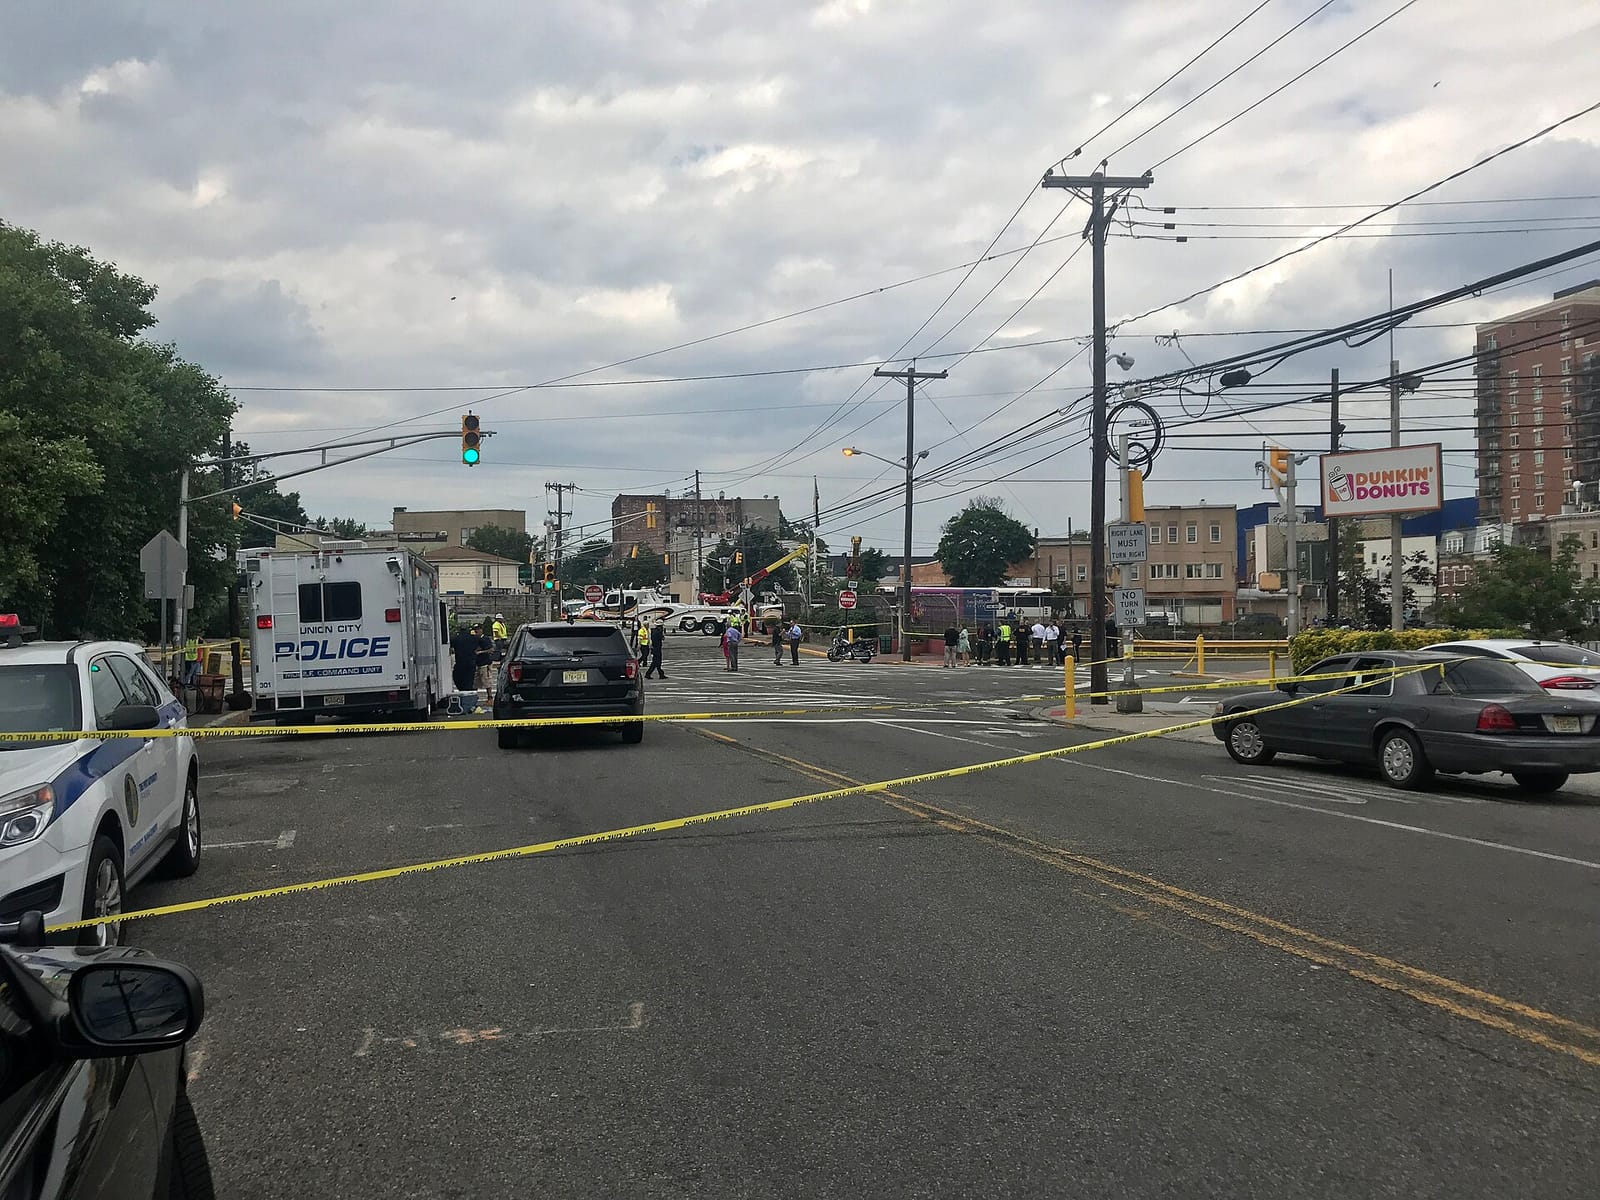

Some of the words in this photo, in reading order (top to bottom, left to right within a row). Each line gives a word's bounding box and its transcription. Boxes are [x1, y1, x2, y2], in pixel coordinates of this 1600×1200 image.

[1355, 467, 1433, 486] DUNKIN'
[1356, 482, 1430, 500] DONUTS
[1117, 539, 1138, 547] MUST
[1128, 550, 1145, 558] RIGHT
[1122, 591, 1136, 600] NO
[300, 625, 333, 635] UNION
[337, 624, 362, 633] CITY
[272, 636, 391, 663] POLICE
[318, 667, 360, 676] COMMAND
[362, 666, 381, 674] UNIT
